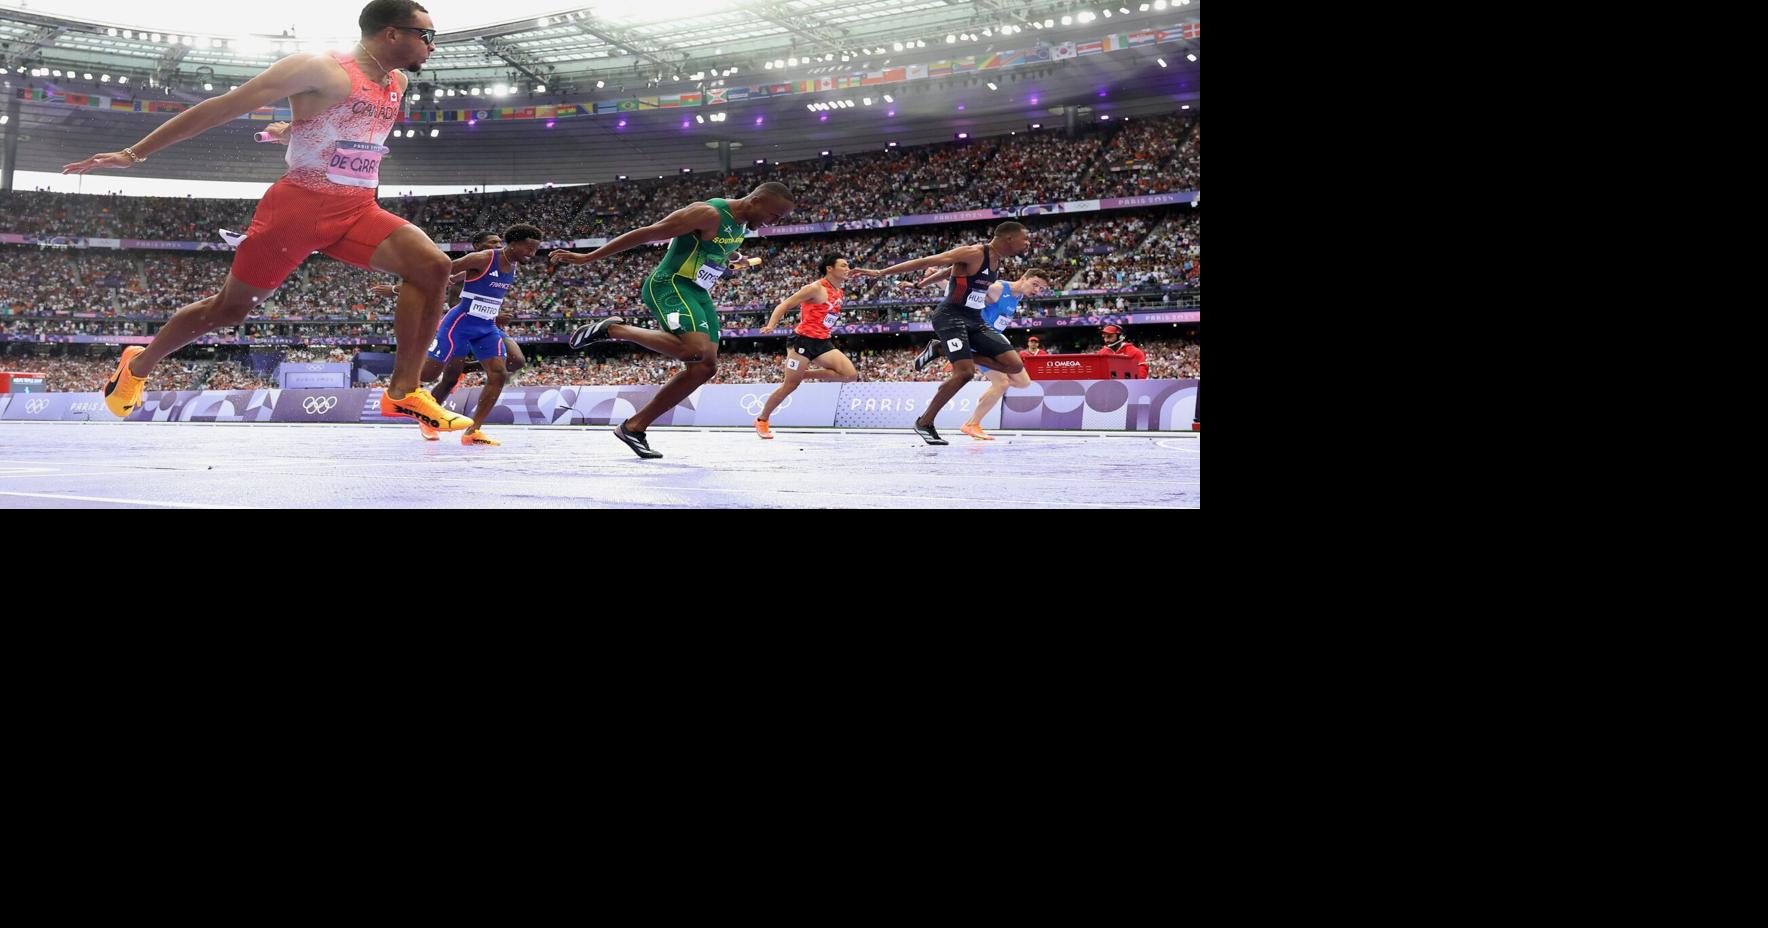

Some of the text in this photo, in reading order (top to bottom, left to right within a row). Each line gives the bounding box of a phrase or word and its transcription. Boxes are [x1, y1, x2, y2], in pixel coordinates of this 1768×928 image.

[330, 155, 349, 169] DE
[789, 360, 797, 368] 3
[850, 398, 915, 412] PARIS
